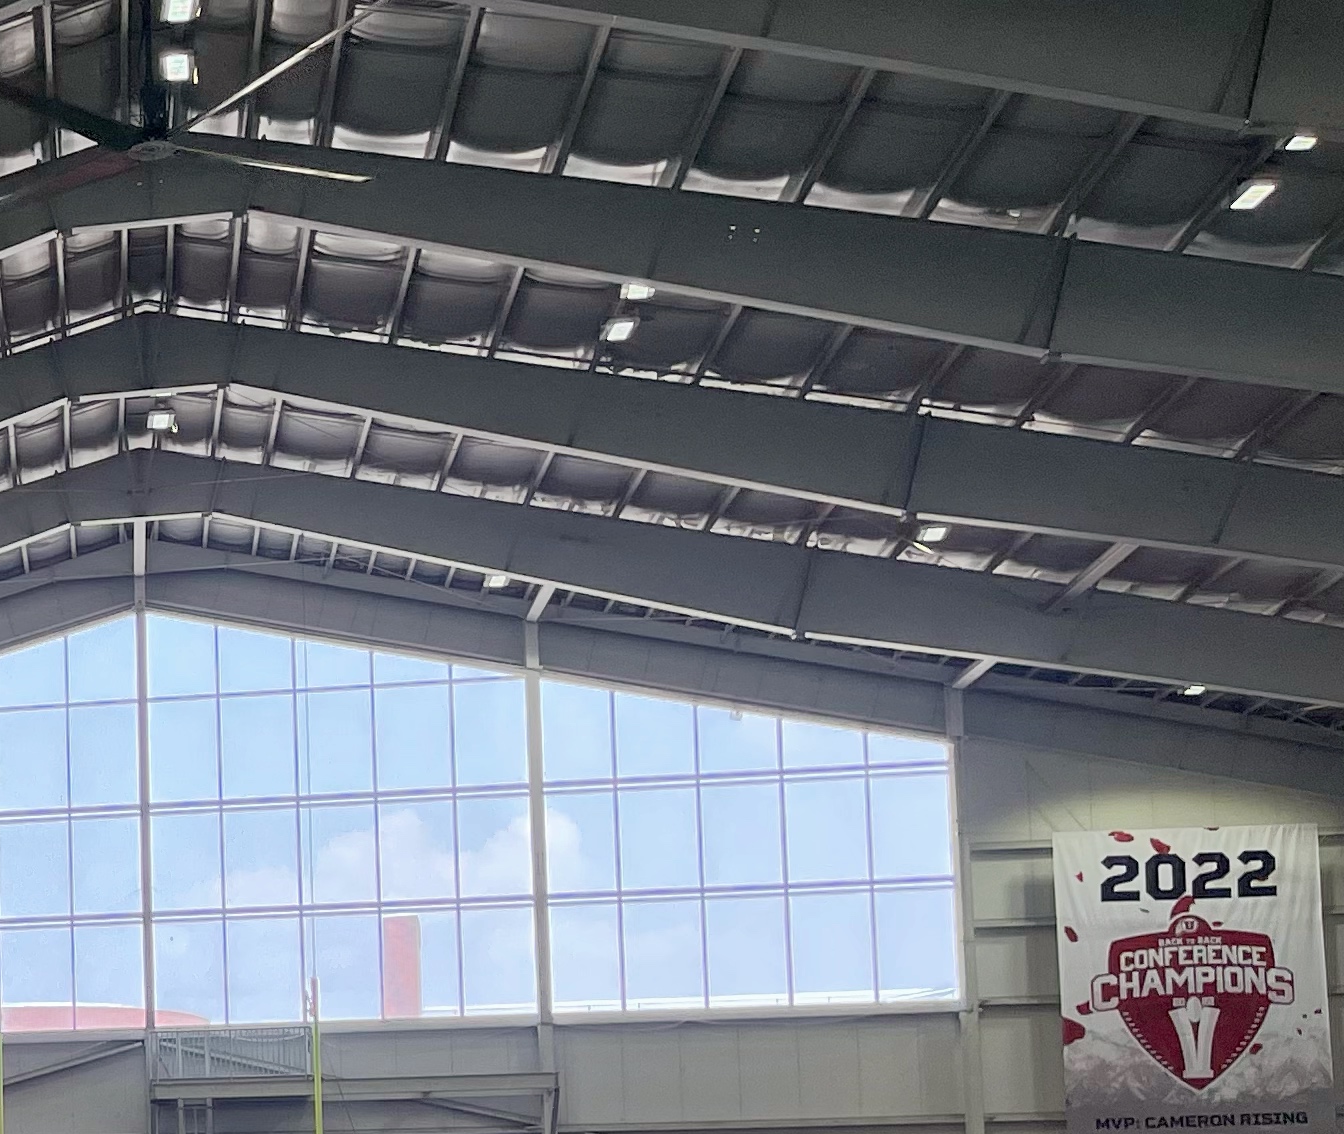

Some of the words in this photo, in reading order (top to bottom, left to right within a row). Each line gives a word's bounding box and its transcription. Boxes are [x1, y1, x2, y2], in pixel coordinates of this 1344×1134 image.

[1100, 850, 1278, 902] 2022
[1119, 945, 1266, 972] CONFERENCE
[1091, 966, 1295, 1012] CHAMPIONS
[1095, 1116, 1140, 1130] MVP:
[1145, 1113, 1236, 1130] CAMERON
[1240, 1110, 1308, 1126] RISING
